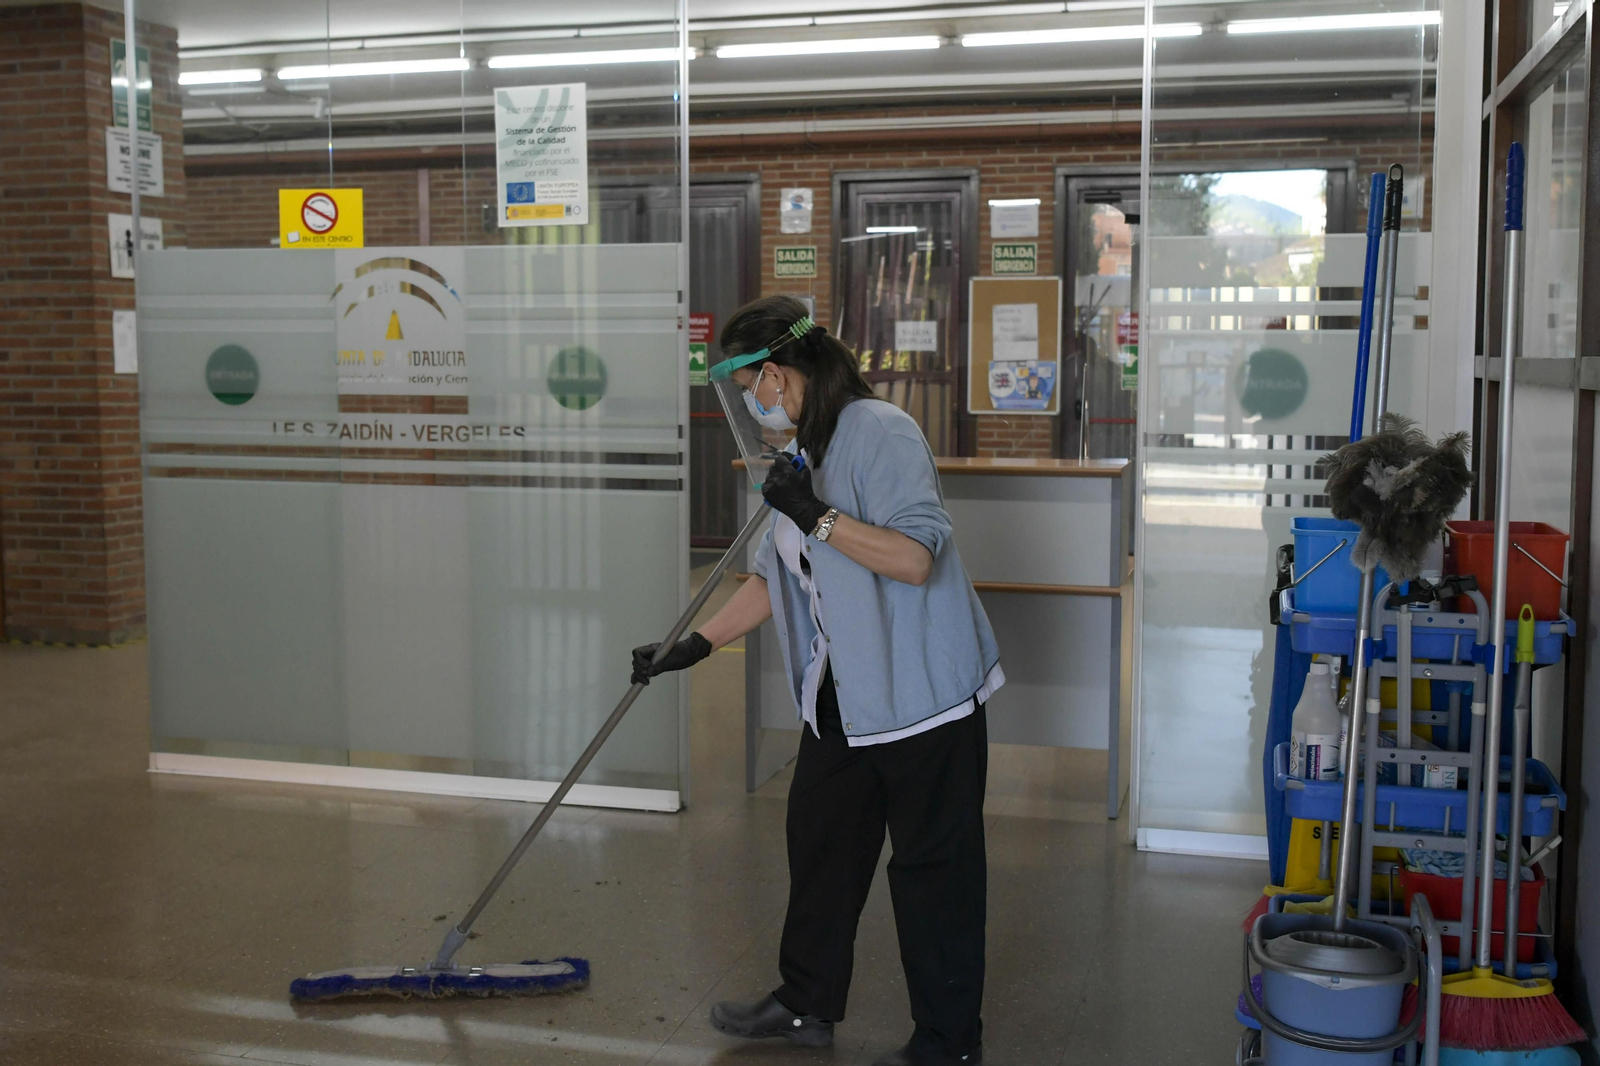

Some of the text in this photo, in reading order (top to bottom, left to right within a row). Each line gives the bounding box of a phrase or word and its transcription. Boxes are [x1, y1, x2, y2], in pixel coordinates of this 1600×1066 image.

[522, 104, 545, 113] centro
[505, 128, 534, 136] Sistema
[547, 125, 576, 133] Gestión
[528, 137, 535, 145] la
[537, 137, 566, 145] Calidad
[550, 148, 563, 157] por
[546, 168, 559, 177] FSE
[302, 235, 354, 243] EN ESTE CENTRO
[777, 250, 813, 261] SALIDA
[995, 247, 1034, 258] SALIDA
[995, 260, 1034, 272] EMERGENCIA
[444, 375, 468, 384] Cien
[326, 419, 393, 441] ZAIDÍN
